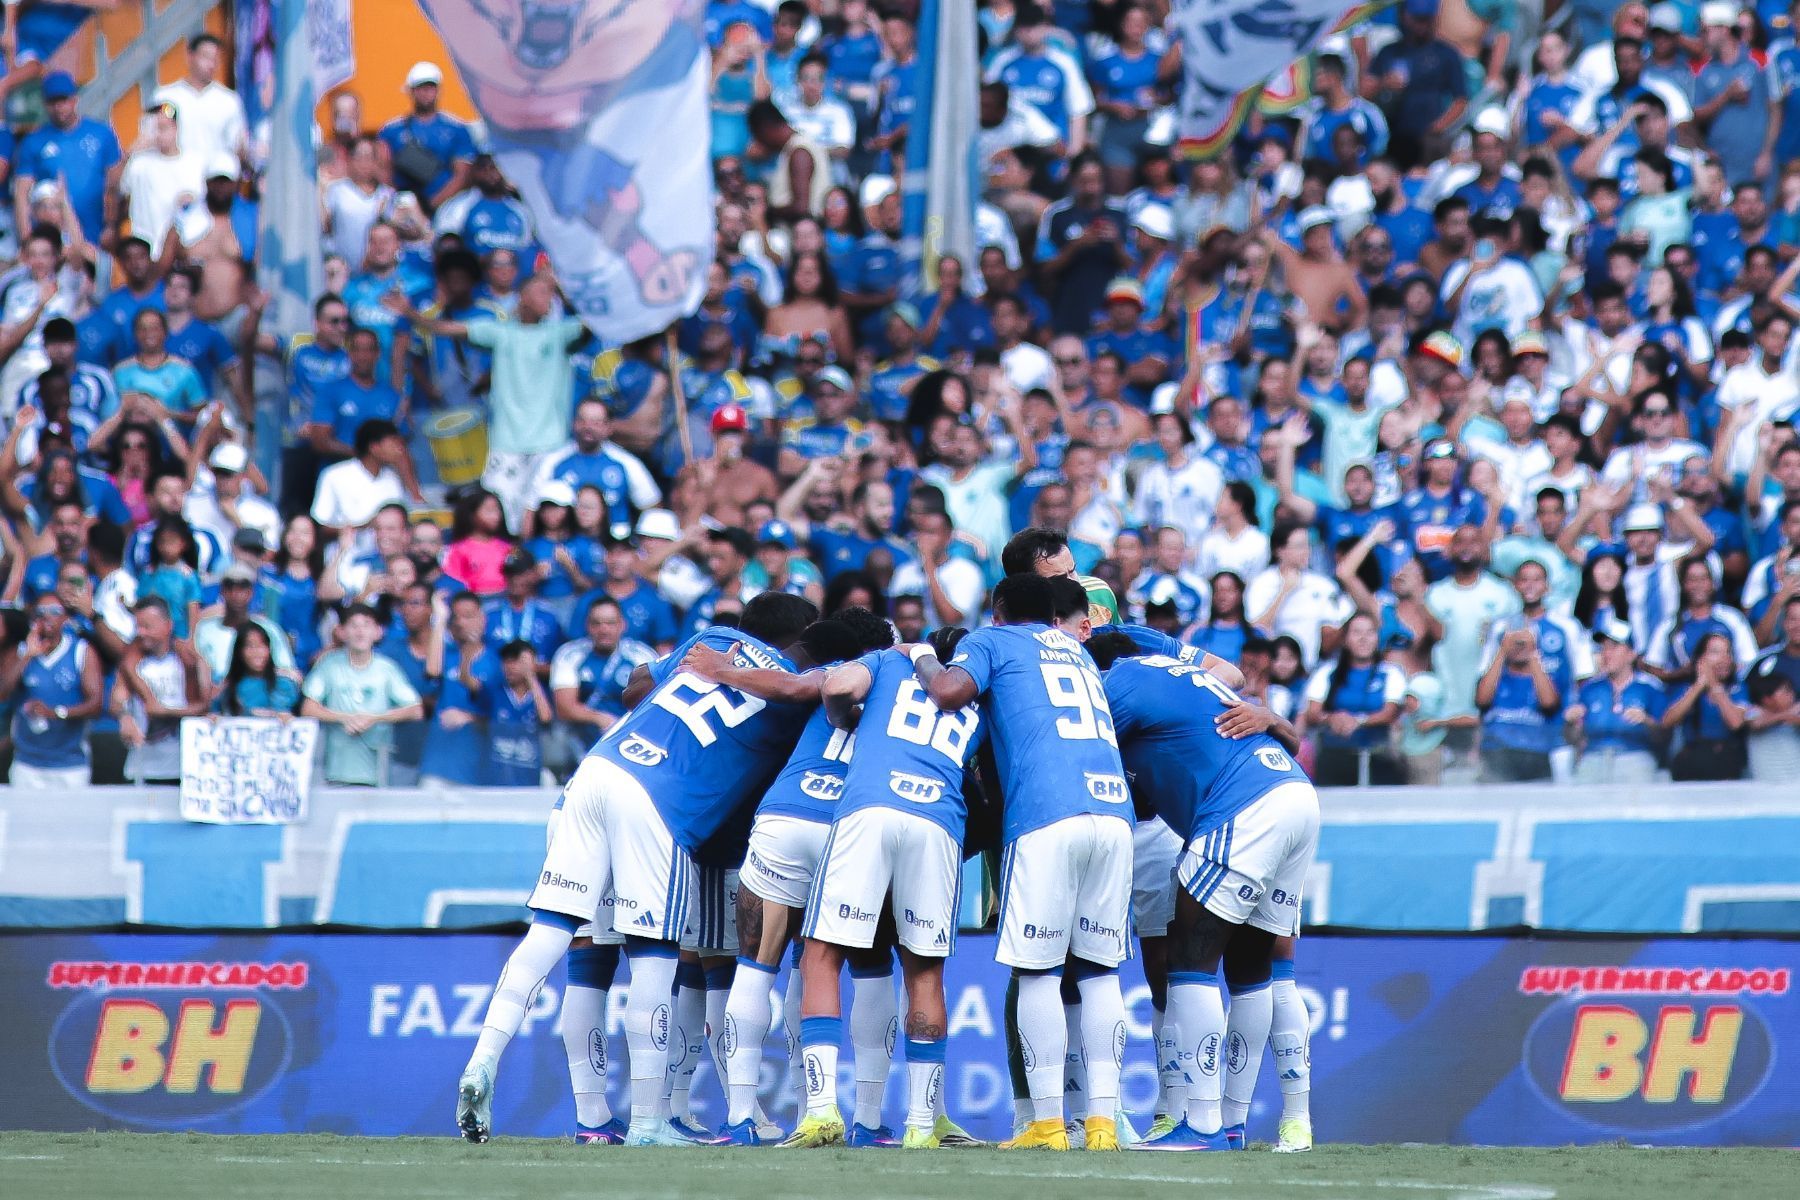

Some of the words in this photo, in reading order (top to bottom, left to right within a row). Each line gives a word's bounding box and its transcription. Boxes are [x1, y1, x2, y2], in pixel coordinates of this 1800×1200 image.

[886, 679, 979, 769] 88
[1039, 664, 1119, 750] 99
[624, 742, 658, 762] BH
[806, 778, 843, 797] BH
[897, 779, 935, 799] BH
[1093, 780, 1123, 798] BH
[550, 873, 588, 894] álamo
[48, 962, 309, 988] SUPERMERCADOS
[1519, 966, 1791, 995] SUPERMERCADOS
[368, 983, 493, 1037] FAZ
[658, 1007, 669, 1046] Kodilar
[85, 999, 262, 1094] BH
[595, 1031, 606, 1071] Kodilar
[1204, 1035, 1218, 1072] Kodilar
[1228, 1034, 1241, 1070] Kodilar
[1276, 1046, 1303, 1057] CEC
[1558, 1004, 1744, 1104] BH
[807, 1057, 820, 1093] Kodilar
[928, 1067, 942, 1104] Kodilar
